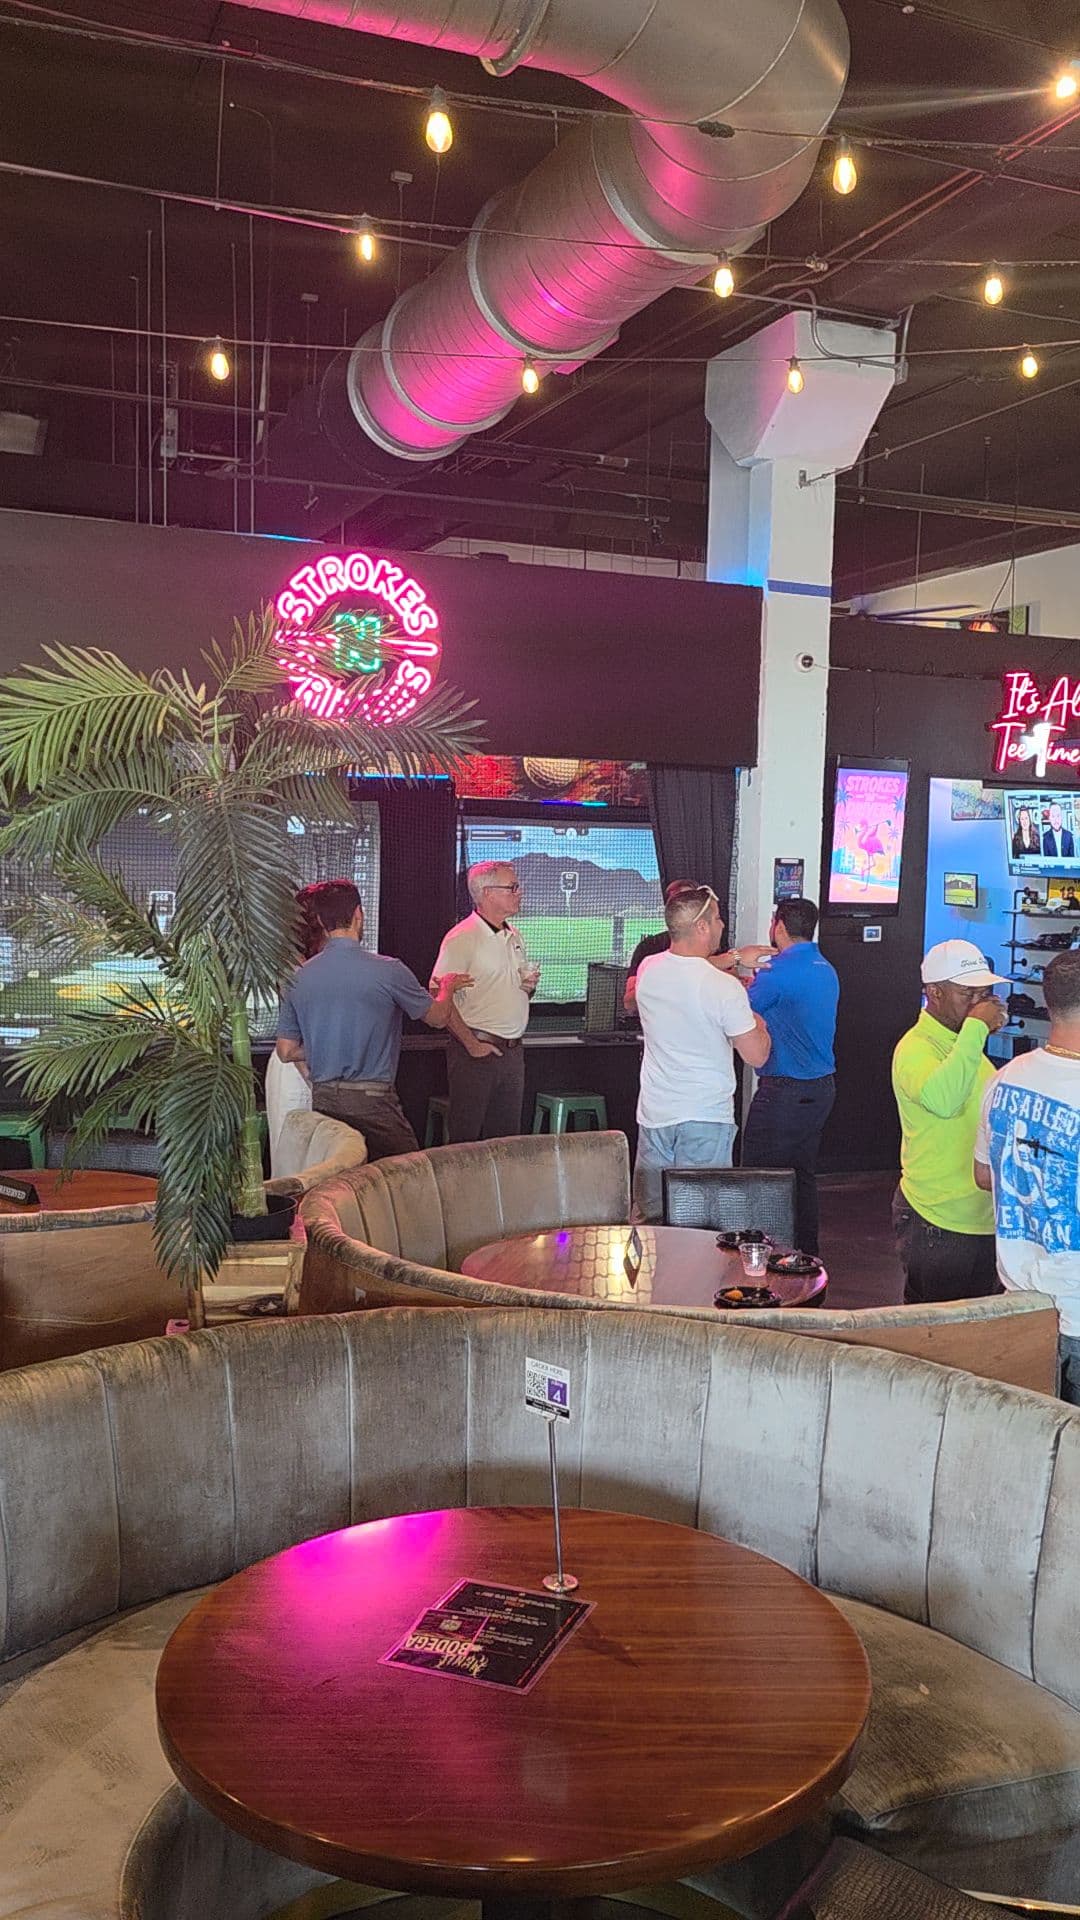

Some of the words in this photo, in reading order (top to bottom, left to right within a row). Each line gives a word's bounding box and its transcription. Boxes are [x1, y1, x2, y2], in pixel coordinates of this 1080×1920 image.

[277, 553, 438, 636] STROKES
[1003, 672, 1041, 719] It's
[991, 722, 1029, 770] Tee
[846, 775, 900, 793] STROKES
[992, 1086, 1080, 1137] DISABLED
[552, 1390, 562, 1402] 4
[405, 1634, 473, 1657] BODEGA
